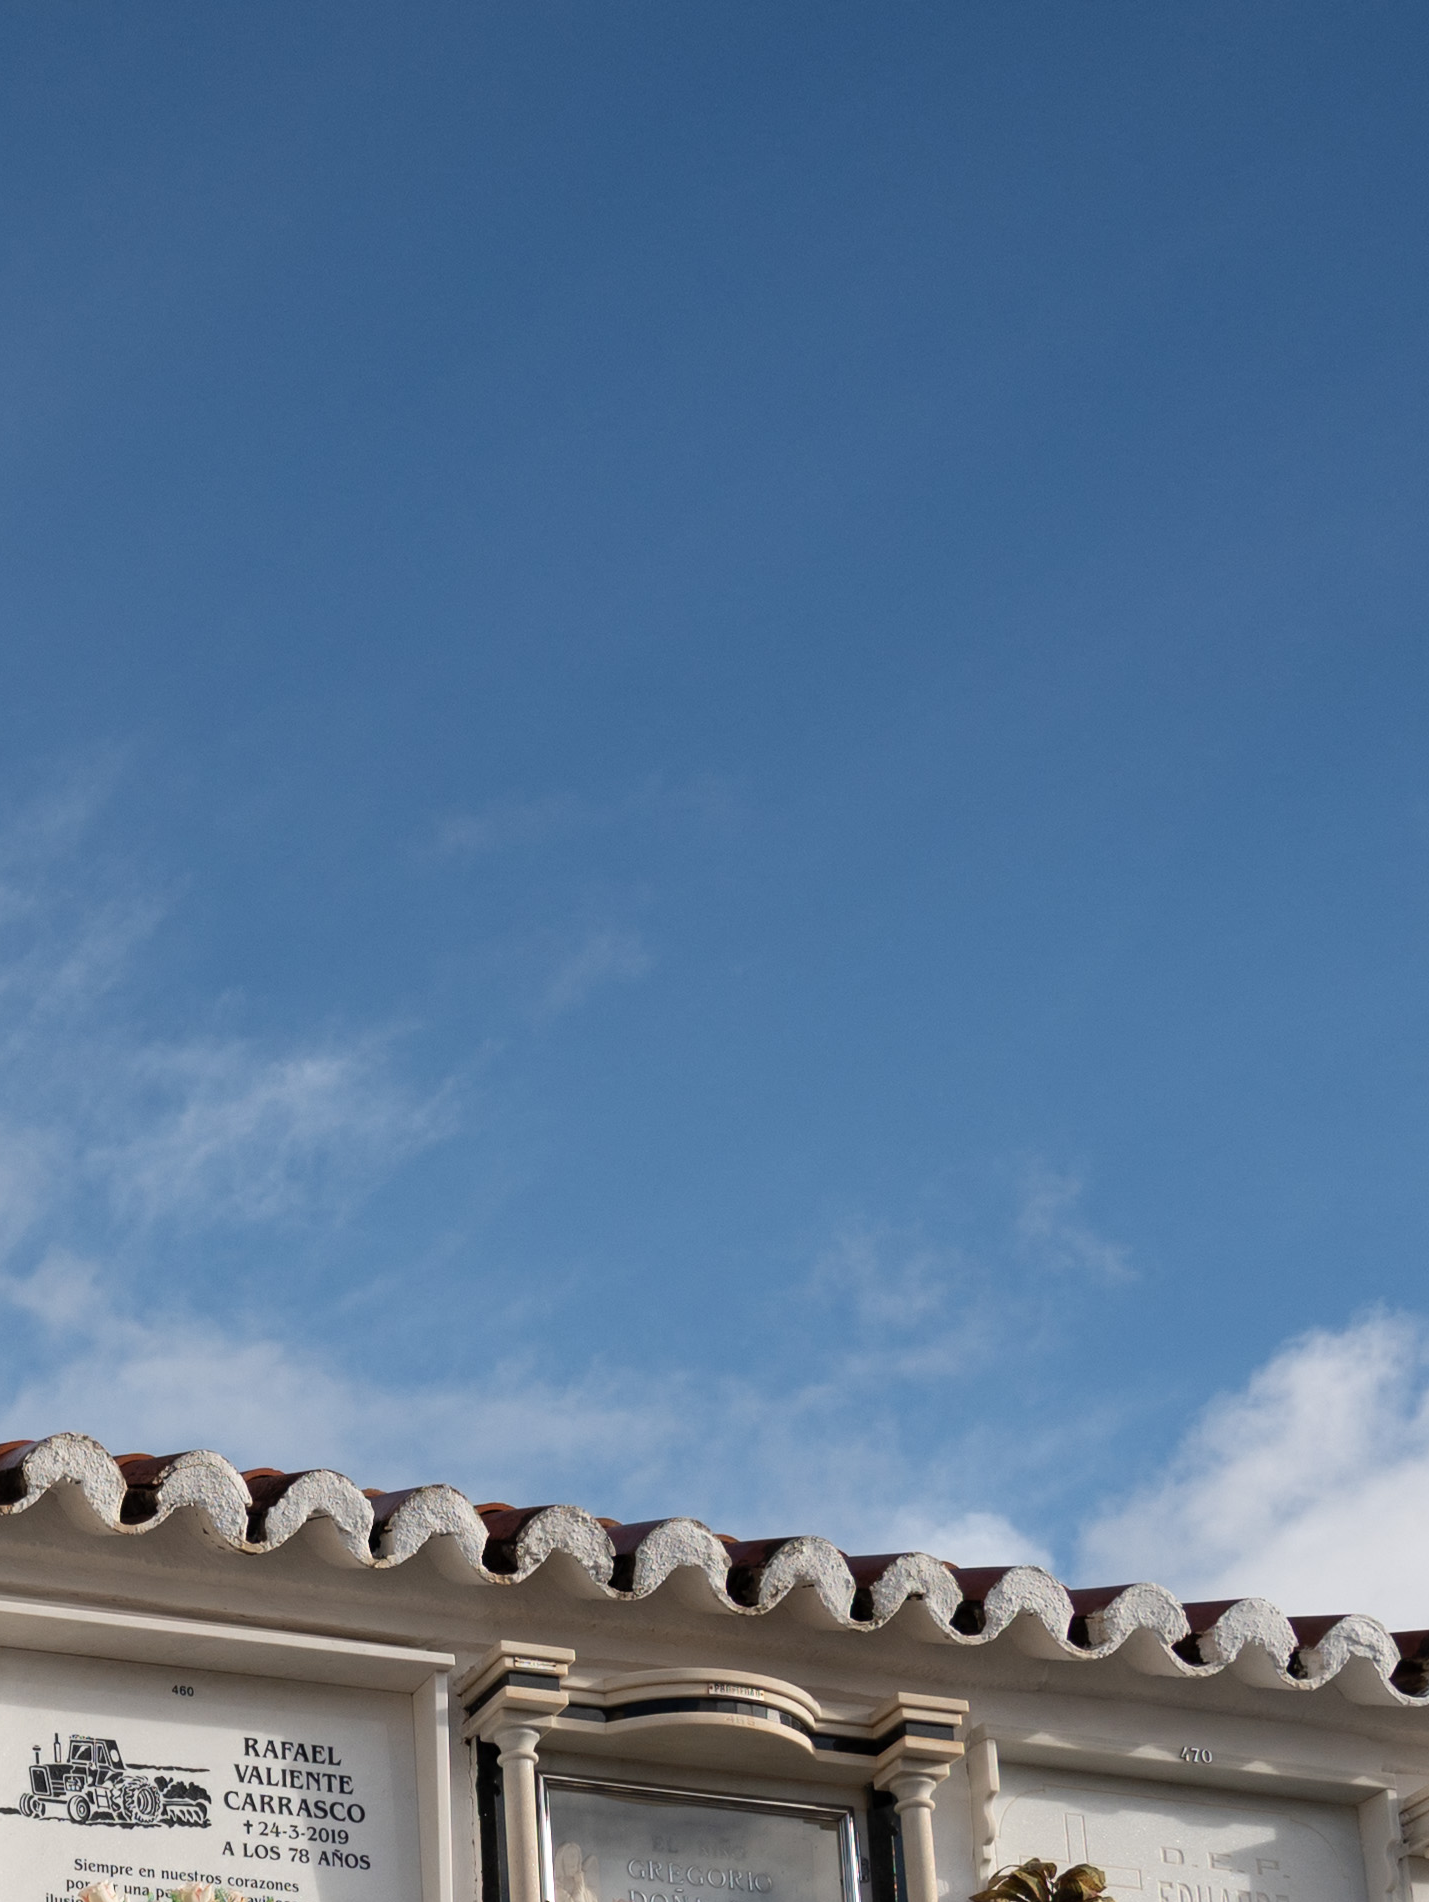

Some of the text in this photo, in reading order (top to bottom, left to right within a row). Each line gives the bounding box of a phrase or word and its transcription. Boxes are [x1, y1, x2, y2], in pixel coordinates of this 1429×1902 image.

[172, 1684, 194, 1697] 460
[243, 1737, 342, 1767] RAFAEL
[1180, 1747, 1215, 1765] 470
[233, 1764, 354, 1795] VALIENTE
[223, 1791, 366, 1823] CARRASCO
[258, 1821, 349, 1845] 24-3-2019
[73, 1858, 300, 1894] Siempre en nuestros corazones
[626, 1857, 775, 1894] GREGORIO
